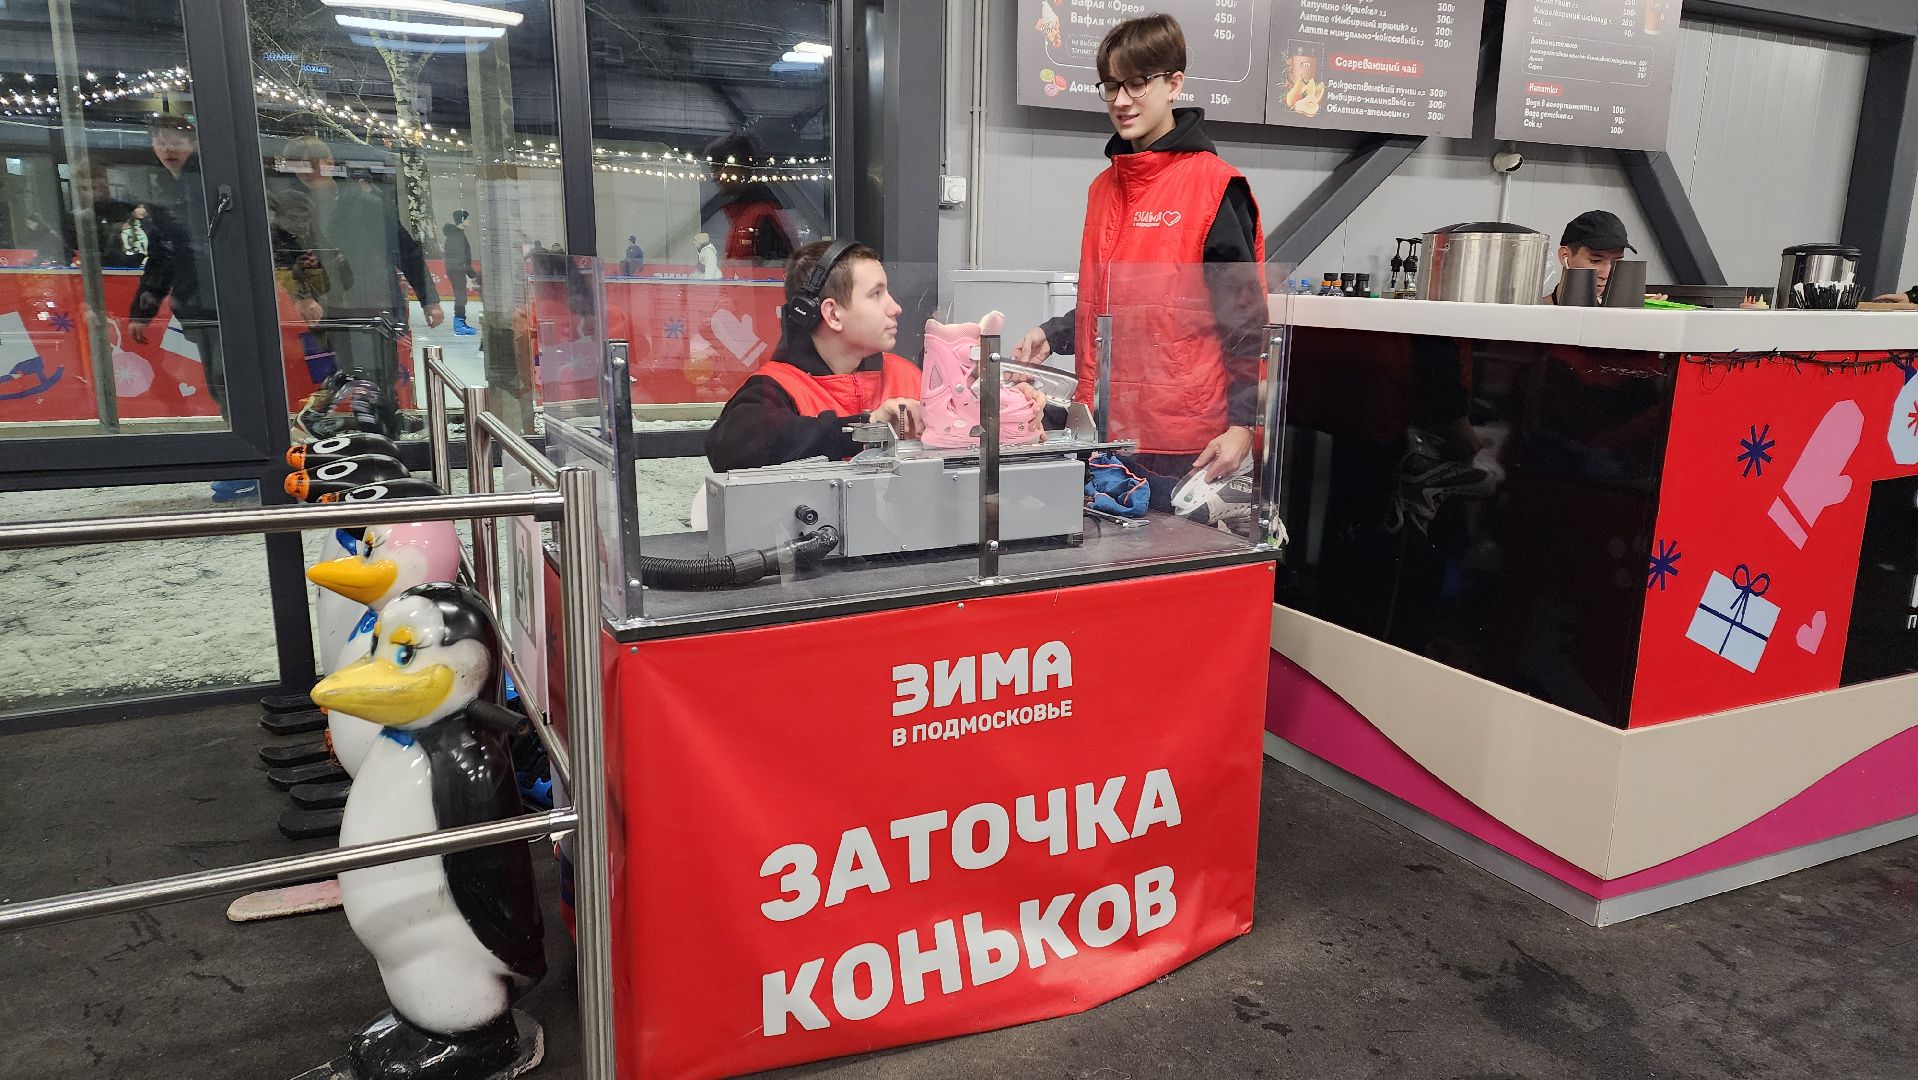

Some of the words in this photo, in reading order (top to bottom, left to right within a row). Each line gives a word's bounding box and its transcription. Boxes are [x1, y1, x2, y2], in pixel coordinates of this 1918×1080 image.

[1300, 0, 1340, 12] Капучино
[1070, 12, 1105, 28] Вафля
[1299, 11, 1330, 24] Латте
[1298, 23, 1329, 37] Латте
[1335, 56, 1400, 73] Согревающий
[1401, 63, 1417, 74] чай
[1069, 81, 1100, 94] Дона
[1328, 79, 1395, 94] Рождественский
[1327, 91, 1407, 107] Имбирно-малиновый
[1525, 98, 1541, 108] Вода
[1326, 103, 1402, 119] Облепиха-апельсин
[1524, 108, 1540, 119] Вода
[1523, 118, 1536, 128] Сок
[892, 640, 1073, 717] ЗИМА
[892, 728, 907, 747] В
[911, 700, 1073, 743] ПОДМОСКОВЬЕ
[759, 768, 1182, 922] ЗАТОЧКА
[762, 864, 1177, 1038] КОНЬКОВ
